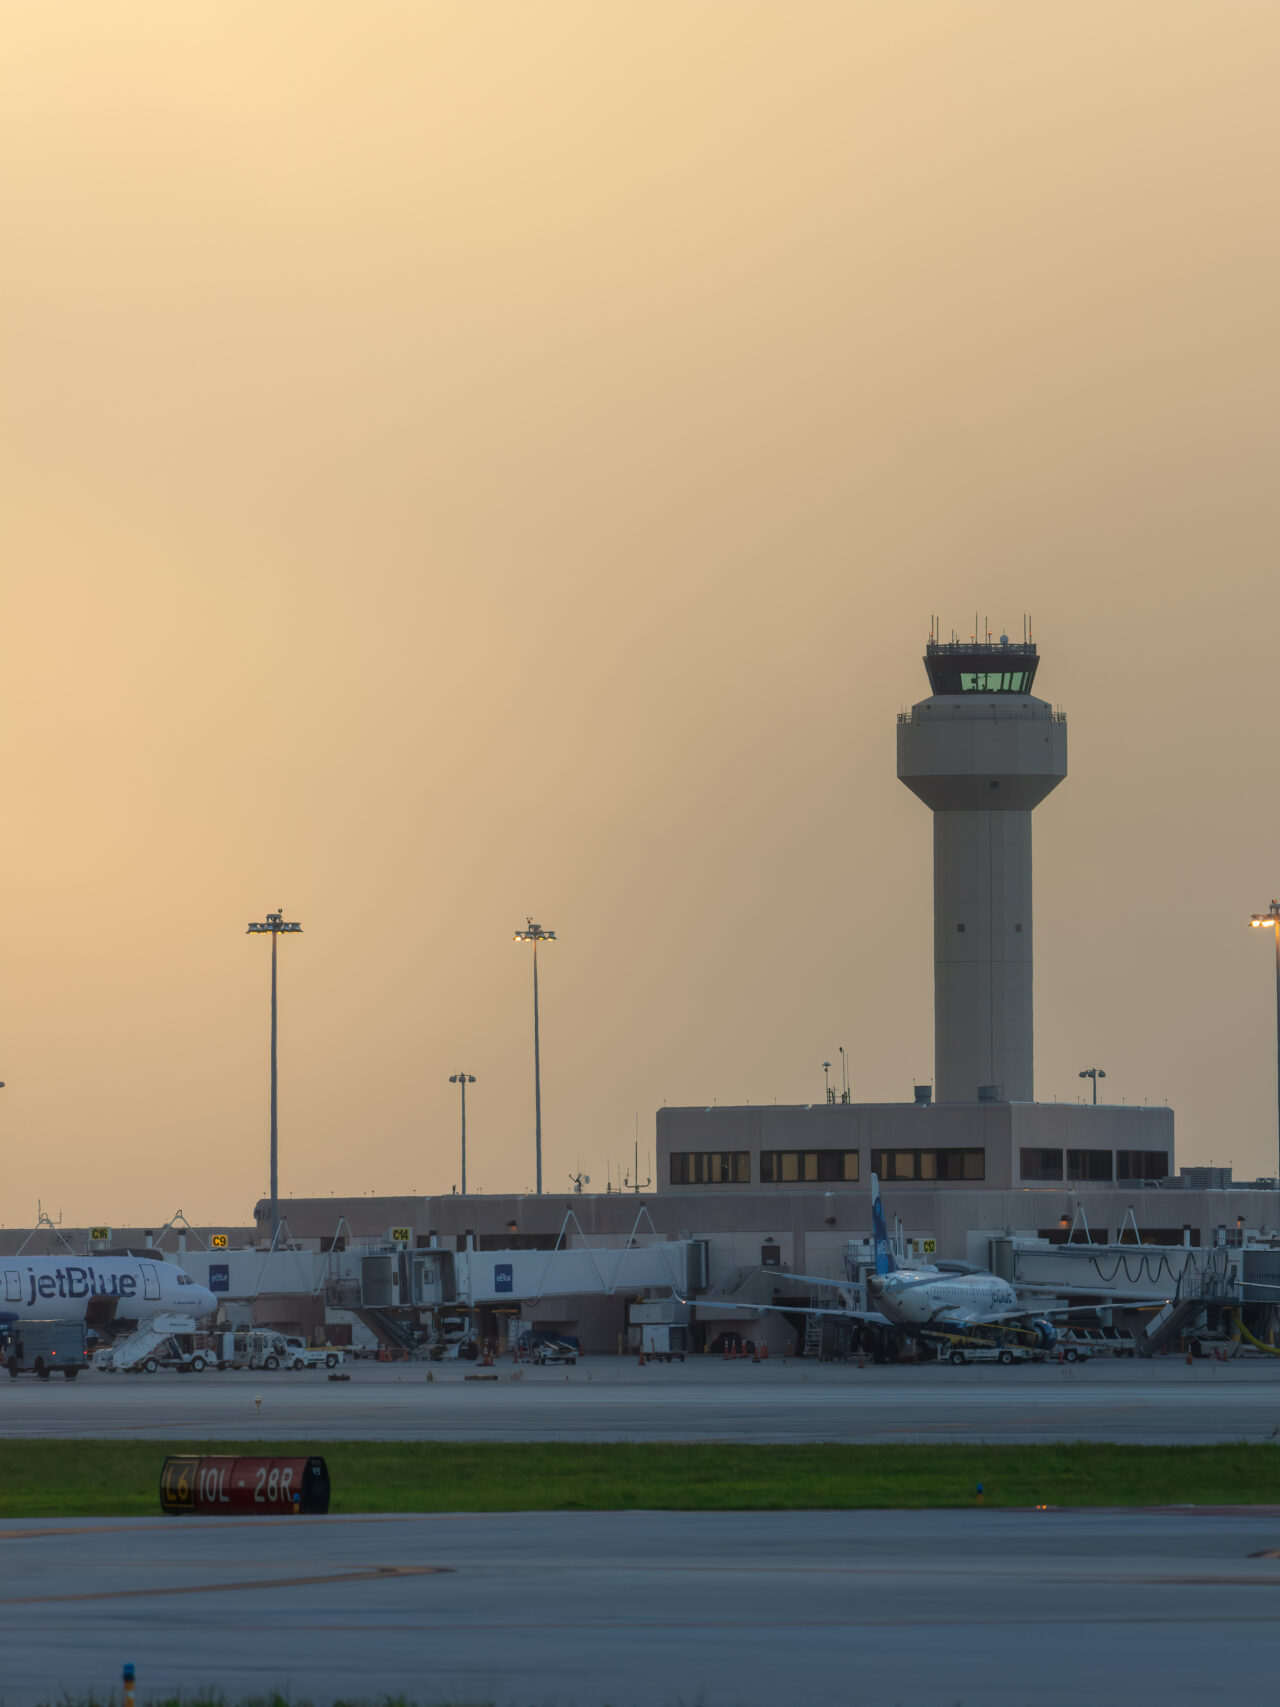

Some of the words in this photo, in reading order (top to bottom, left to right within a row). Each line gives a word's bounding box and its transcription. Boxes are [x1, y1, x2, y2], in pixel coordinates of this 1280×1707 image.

[393, 1229, 409, 1240] C14
[213, 1236, 226, 1247] C9
[924, 1240, 935, 1252] C12
[27, 1267, 137, 1306] jetBlue
[166, 1466, 189, 1501] L6
[200, 1467, 230, 1502] 10L
[254, 1467, 293, 1502] 28R
